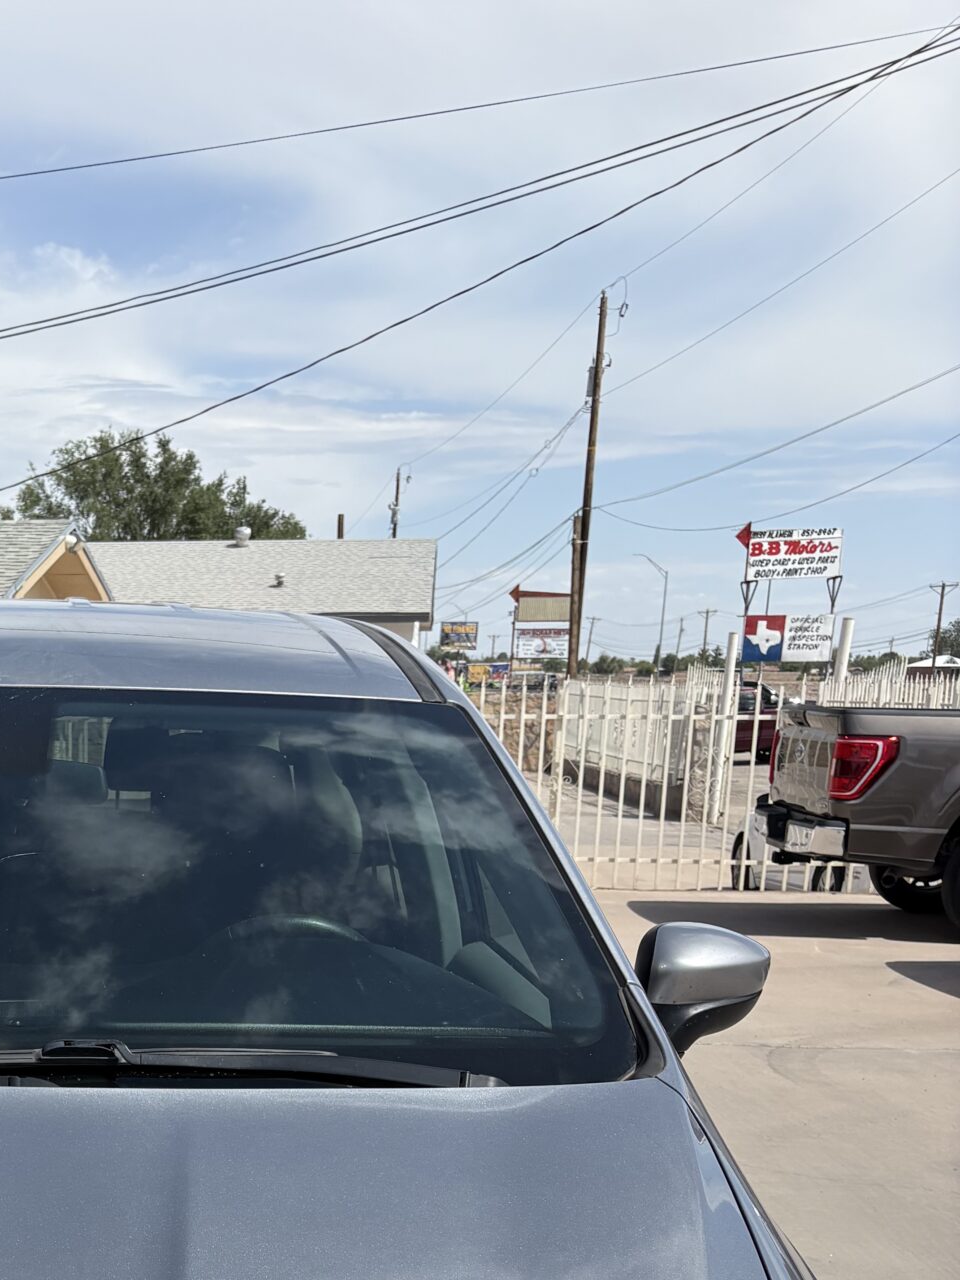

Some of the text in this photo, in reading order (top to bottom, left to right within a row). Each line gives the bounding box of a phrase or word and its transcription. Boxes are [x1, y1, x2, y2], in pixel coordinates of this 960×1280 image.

[784, 539, 839, 556] Motors
[751, 559, 771, 567] USED
[772, 558, 791, 566] CARS
[798, 557, 816, 565] USED
[816, 556, 838, 565] PARTS
[754, 569, 777, 578] BODY
[781, 568, 805, 577] PAINT
[804, 566, 828, 575] SHOP
[788, 634, 833, 642] INSPECTION
